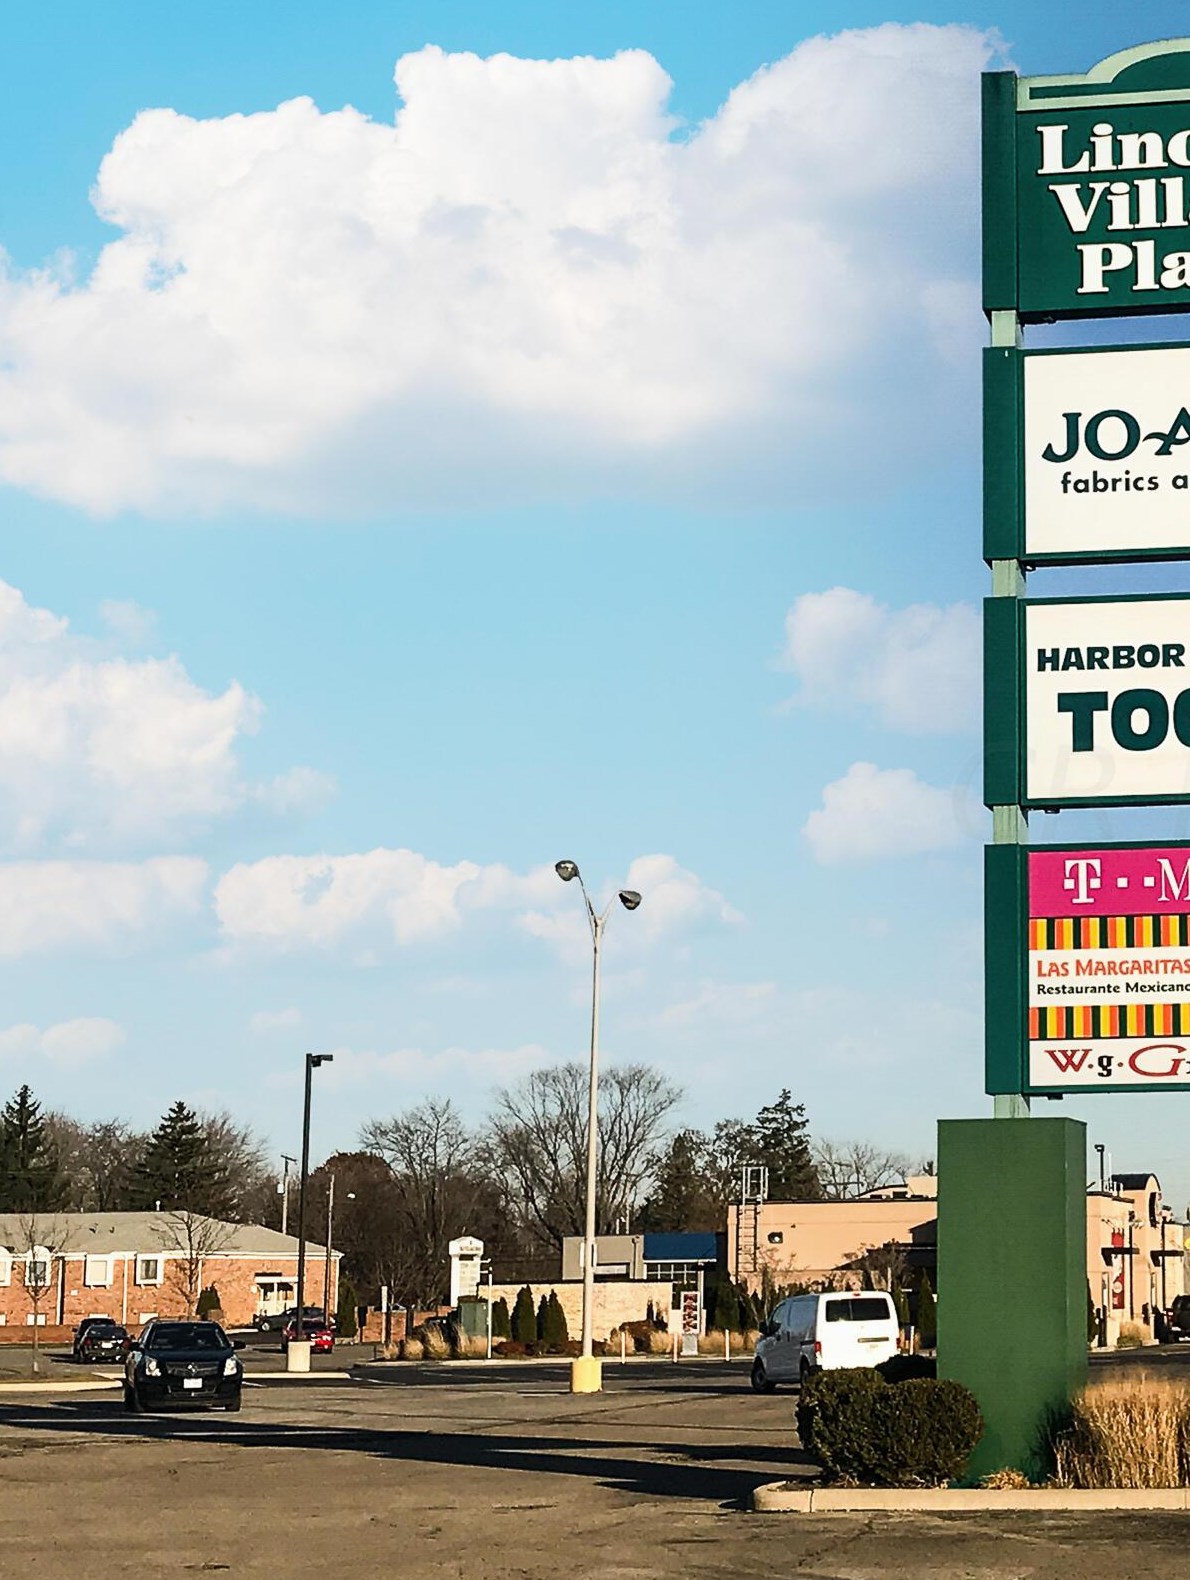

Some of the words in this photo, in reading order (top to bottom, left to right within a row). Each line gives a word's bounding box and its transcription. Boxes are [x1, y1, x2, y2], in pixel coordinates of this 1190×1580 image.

[1061, 470, 1159, 493] fabrics
[1037, 644, 1185, 672] HARBOR
[1038, 961, 1069, 977] LAS
[1038, 984, 1120, 994] Restaurante
